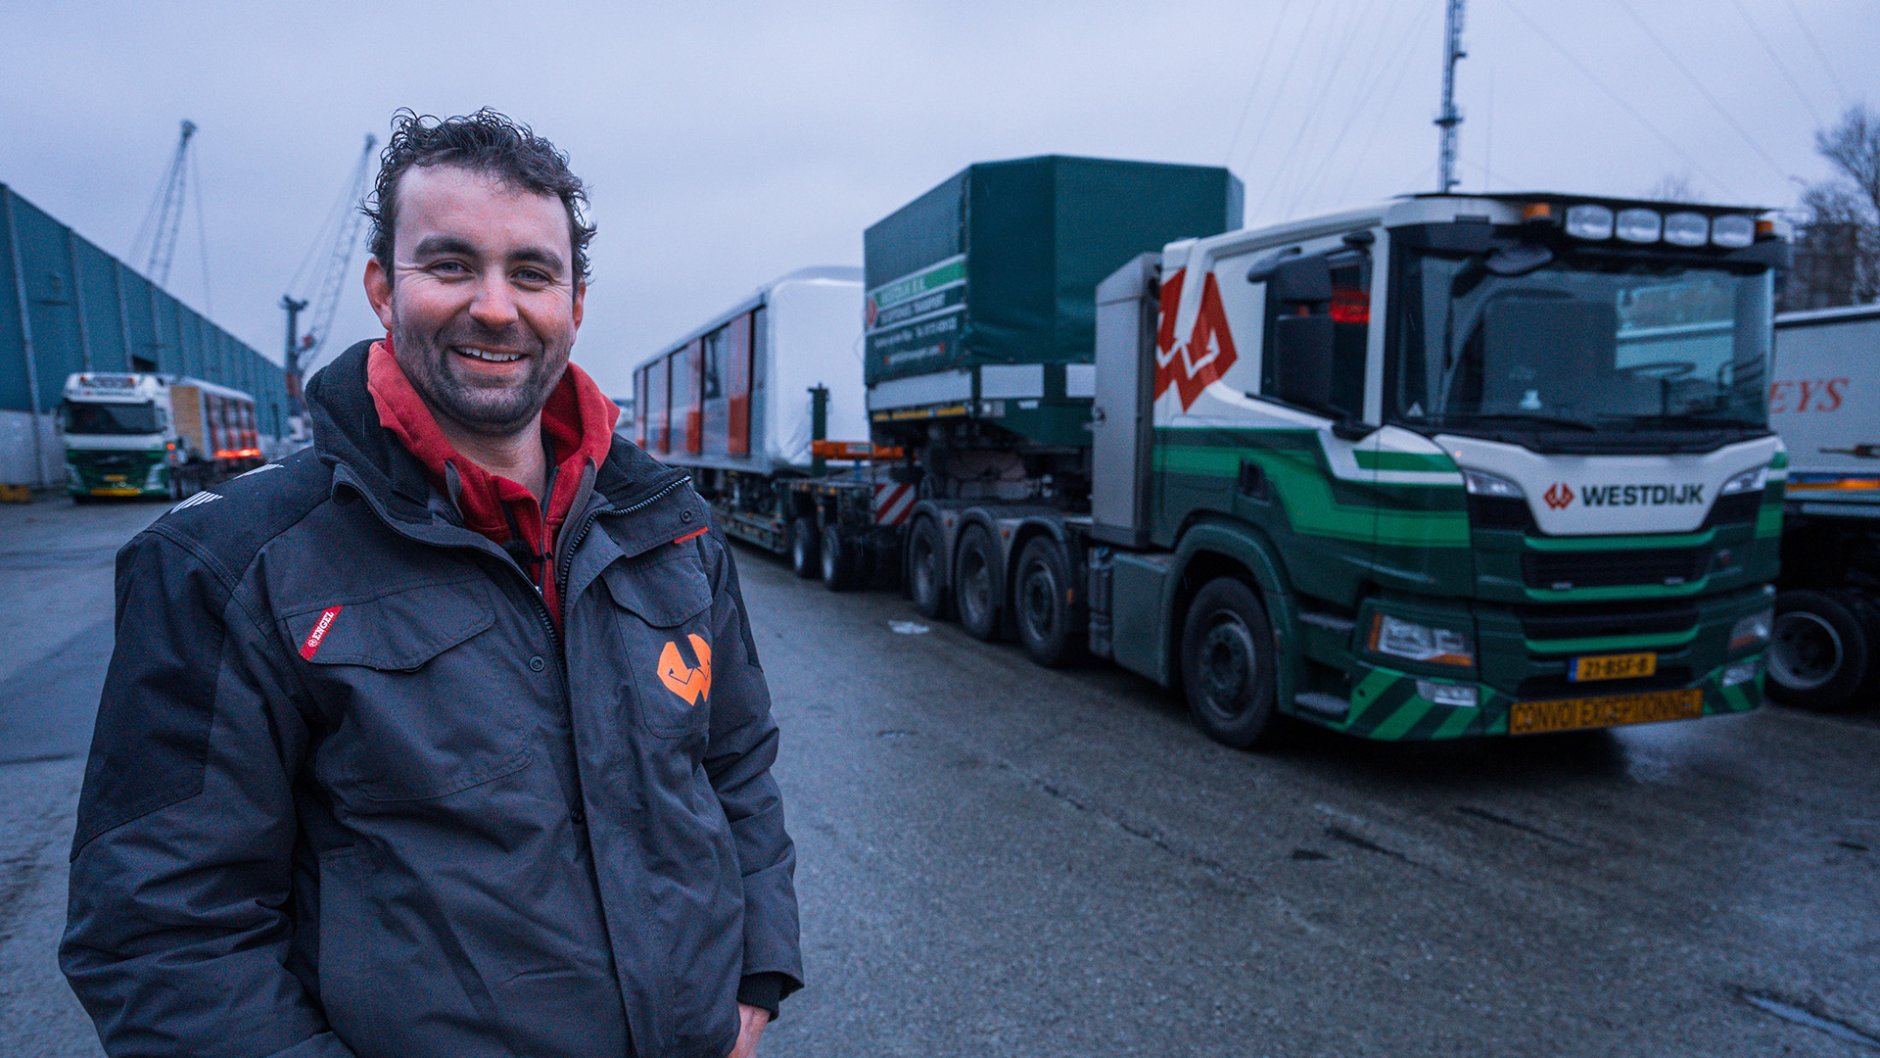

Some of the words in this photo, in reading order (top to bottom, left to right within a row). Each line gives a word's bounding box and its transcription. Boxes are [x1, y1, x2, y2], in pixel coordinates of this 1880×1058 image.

[1582, 483, 1704, 507] WESTDIJK
[311, 611, 335, 641] ENGEL
[1512, 701, 1577, 732] CONVOI
